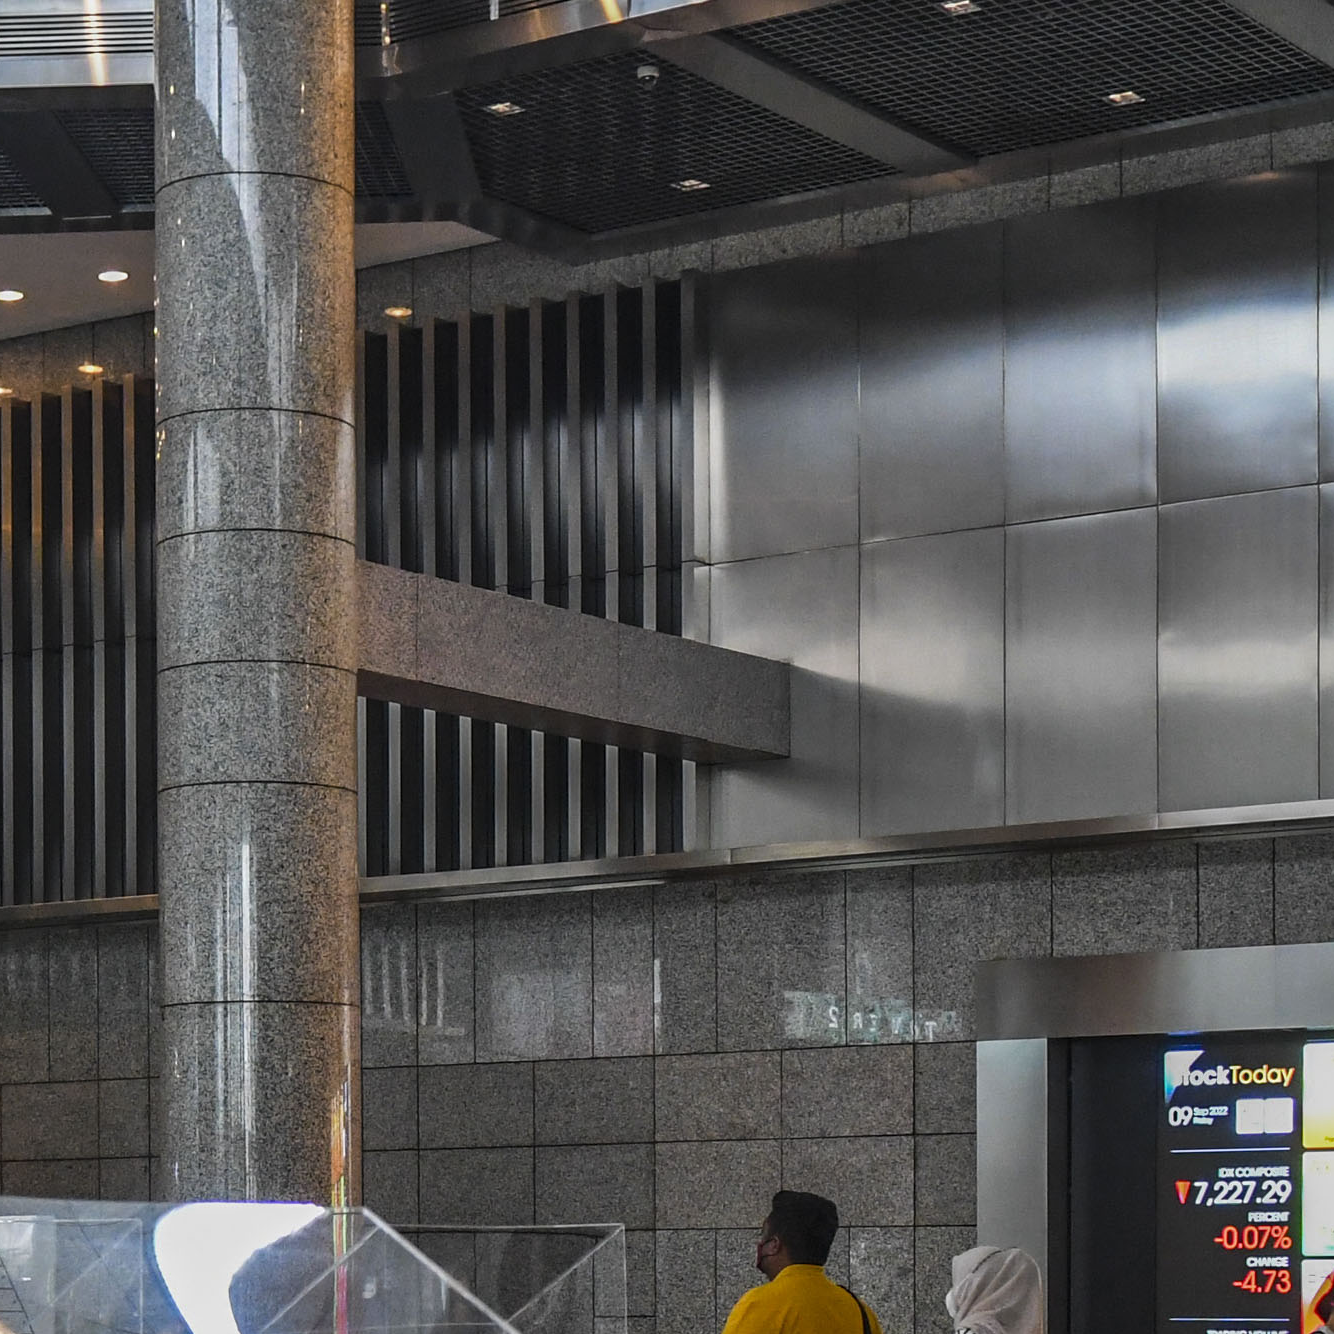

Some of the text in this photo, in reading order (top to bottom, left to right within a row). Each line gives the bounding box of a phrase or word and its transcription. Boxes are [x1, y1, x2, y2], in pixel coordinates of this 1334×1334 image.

[1168, 1106, 1193, 1126] 09
[1218, 1166, 1291, 1178] IDX COMPOSITE
[1193, 1179, 1293, 1207] 7,227.29
[1248, 1212, 1291, 1223] PERCENT
[1213, 1225, 1293, 1249] -0.07%
[1246, 1256, 1290, 1268] CHANGE
[1232, 1269, 1293, 1294] -4.73
